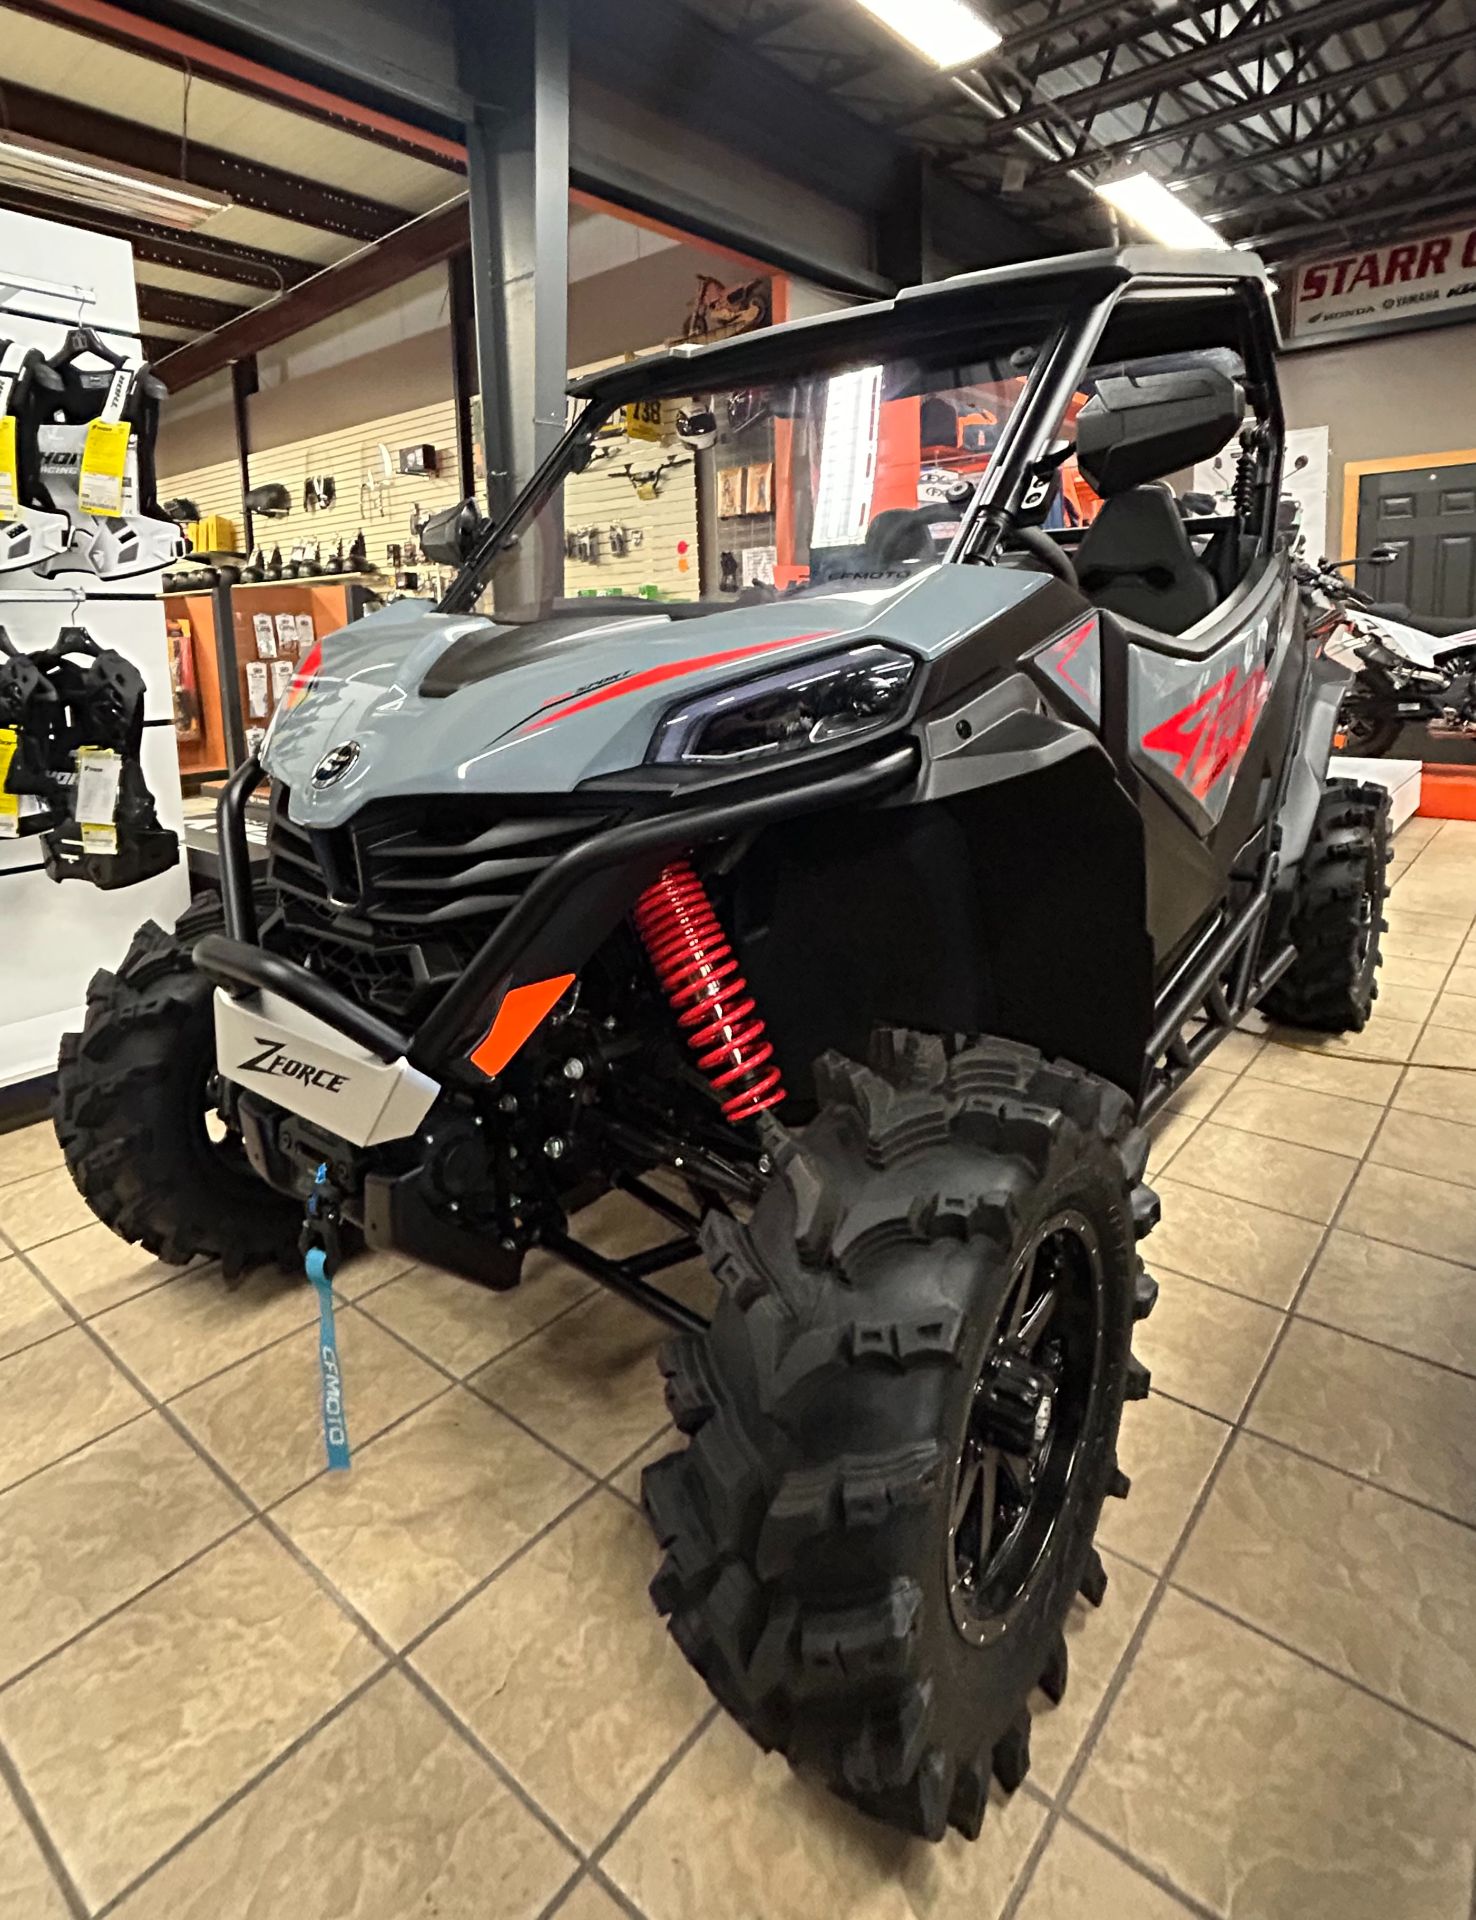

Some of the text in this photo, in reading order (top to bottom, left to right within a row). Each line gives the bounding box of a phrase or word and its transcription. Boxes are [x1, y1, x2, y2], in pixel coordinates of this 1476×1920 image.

[1299, 236, 1453, 303] STARR
[1323, 305, 1376, 321] HONDA
[1396, 289, 1440, 308] YAMAHA
[828, 570, 911, 581] CFMOTO
[237, 1036, 351, 1093] ZFORCE
[322, 1345, 345, 1446] CFMOTO
